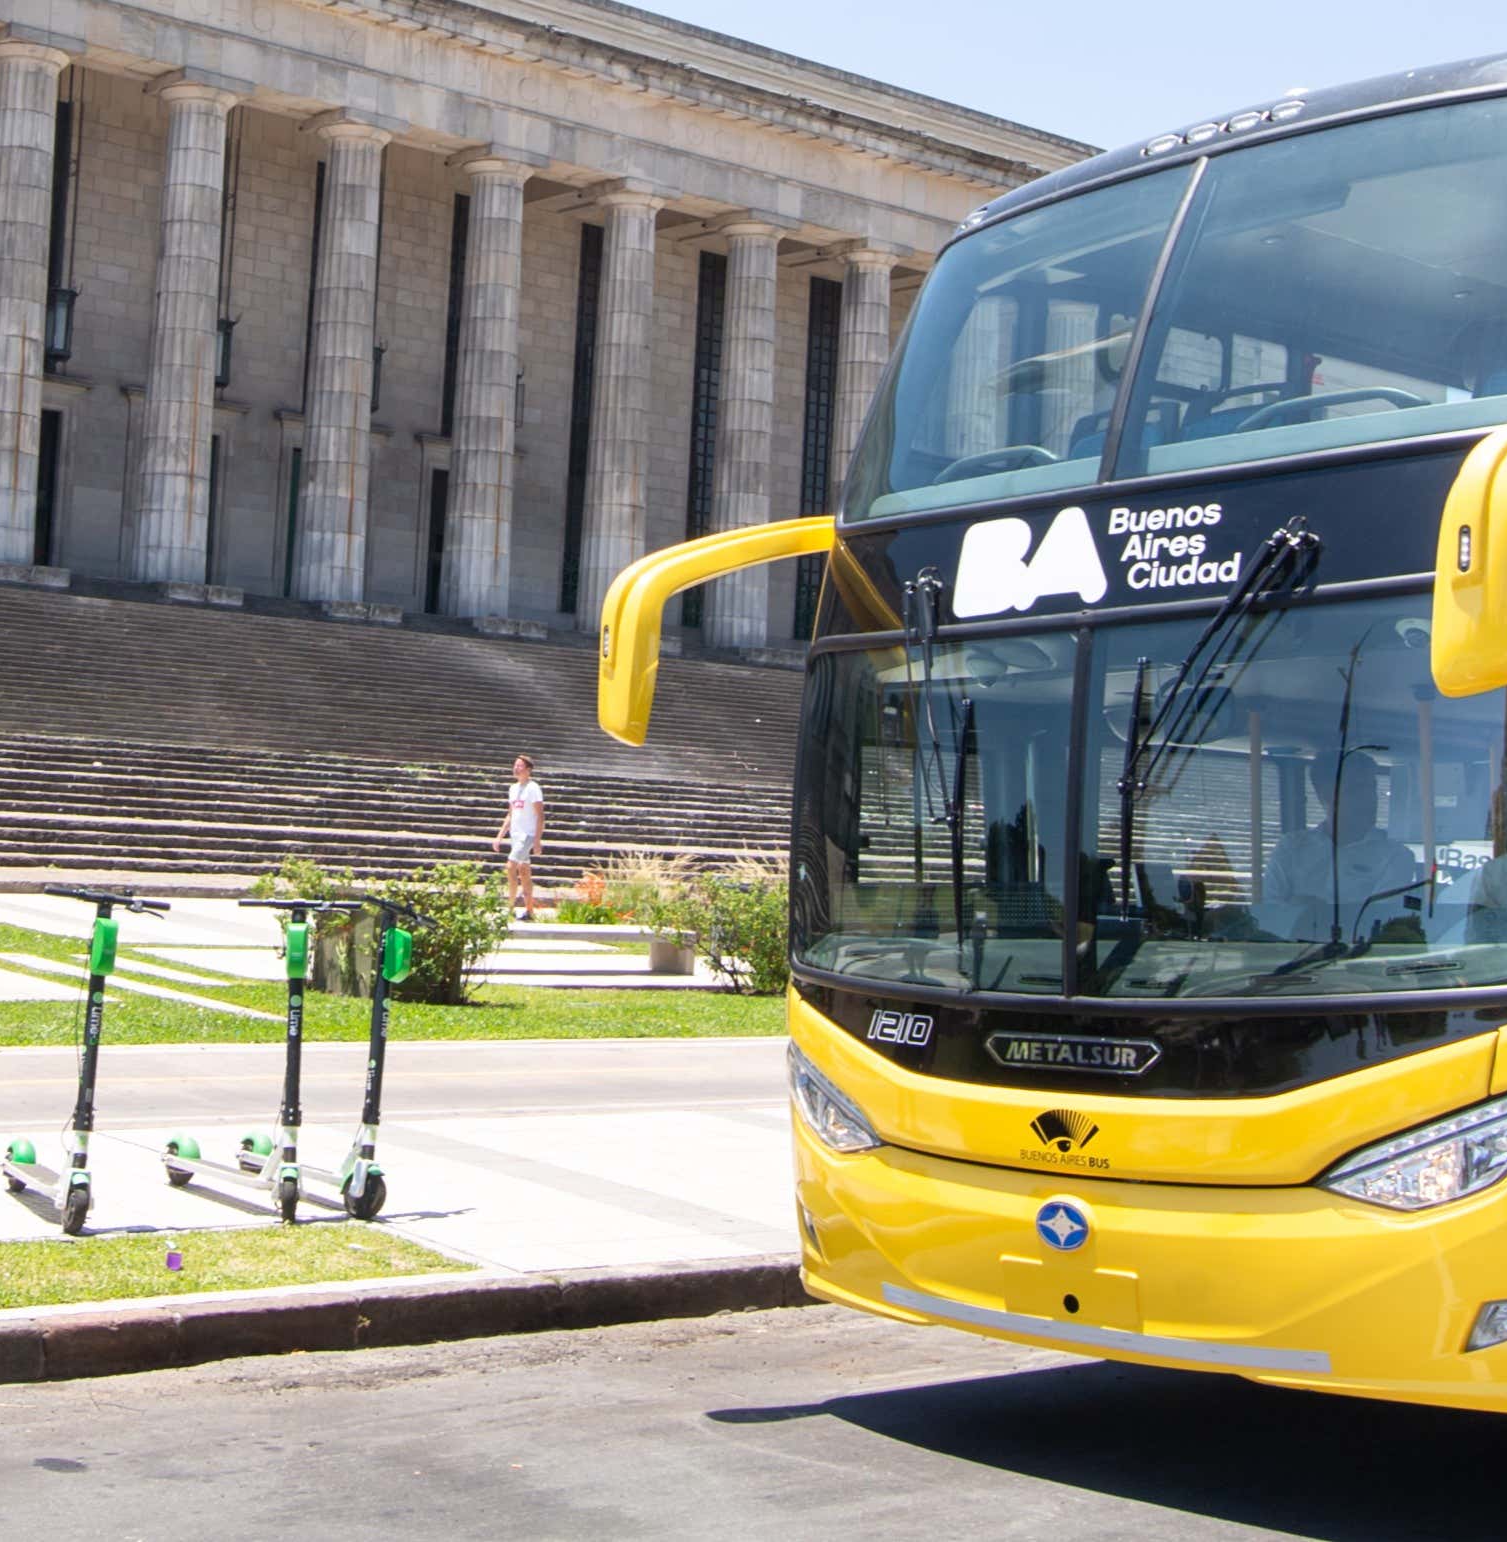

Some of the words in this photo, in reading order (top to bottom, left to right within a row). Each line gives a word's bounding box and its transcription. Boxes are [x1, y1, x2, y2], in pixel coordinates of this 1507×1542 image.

[1108, 503, 1222, 535] Buenos
[952, 506, 1108, 619] BA
[1120, 533, 1207, 562] Aires
[1127, 552, 1242, 590] Ciudad
[290, 1009, 301, 1036] Lime
[867, 1010, 933, 1046] 1210
[1005, 1041, 1137, 1067] METALSUR
[1020, 1149, 1058, 1164] BUENOS
[1060, 1154, 1087, 1167] AIRES
[1089, 1157, 1110, 1169] BUS
